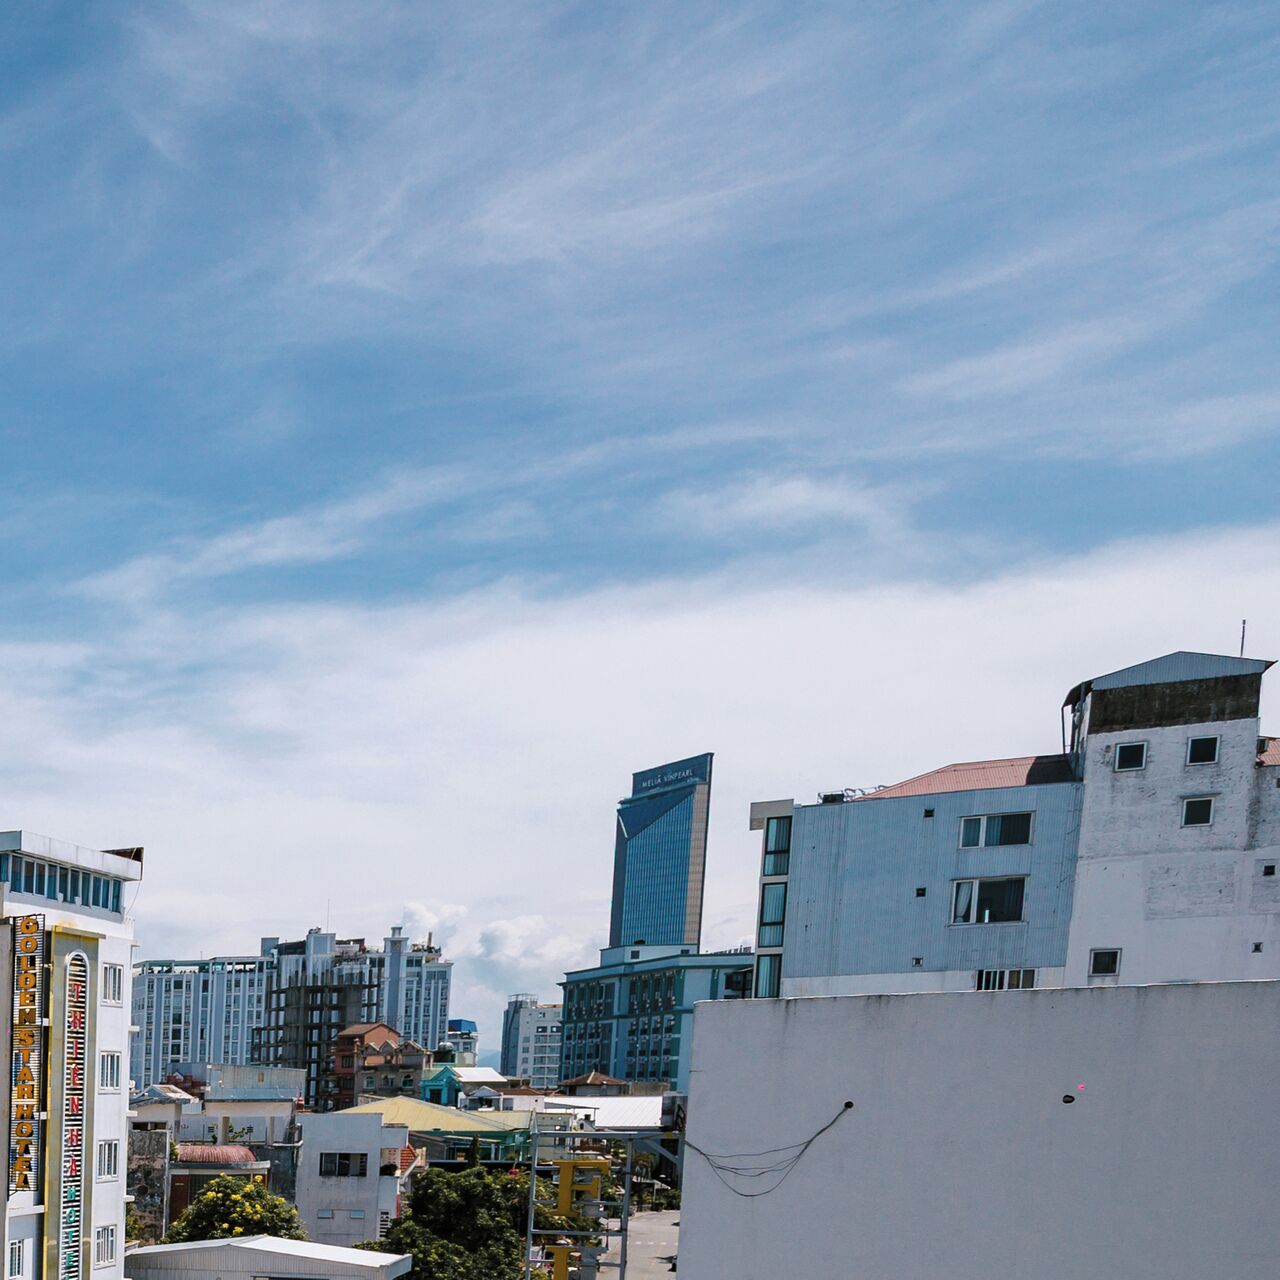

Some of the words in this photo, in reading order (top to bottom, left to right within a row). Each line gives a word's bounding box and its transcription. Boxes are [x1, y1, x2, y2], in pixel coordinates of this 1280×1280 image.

[18, 916, 38, 1026] GOLDEN
[15, 1029, 35, 1100] STAR
[14, 1102, 35, 1190] HOTEL
